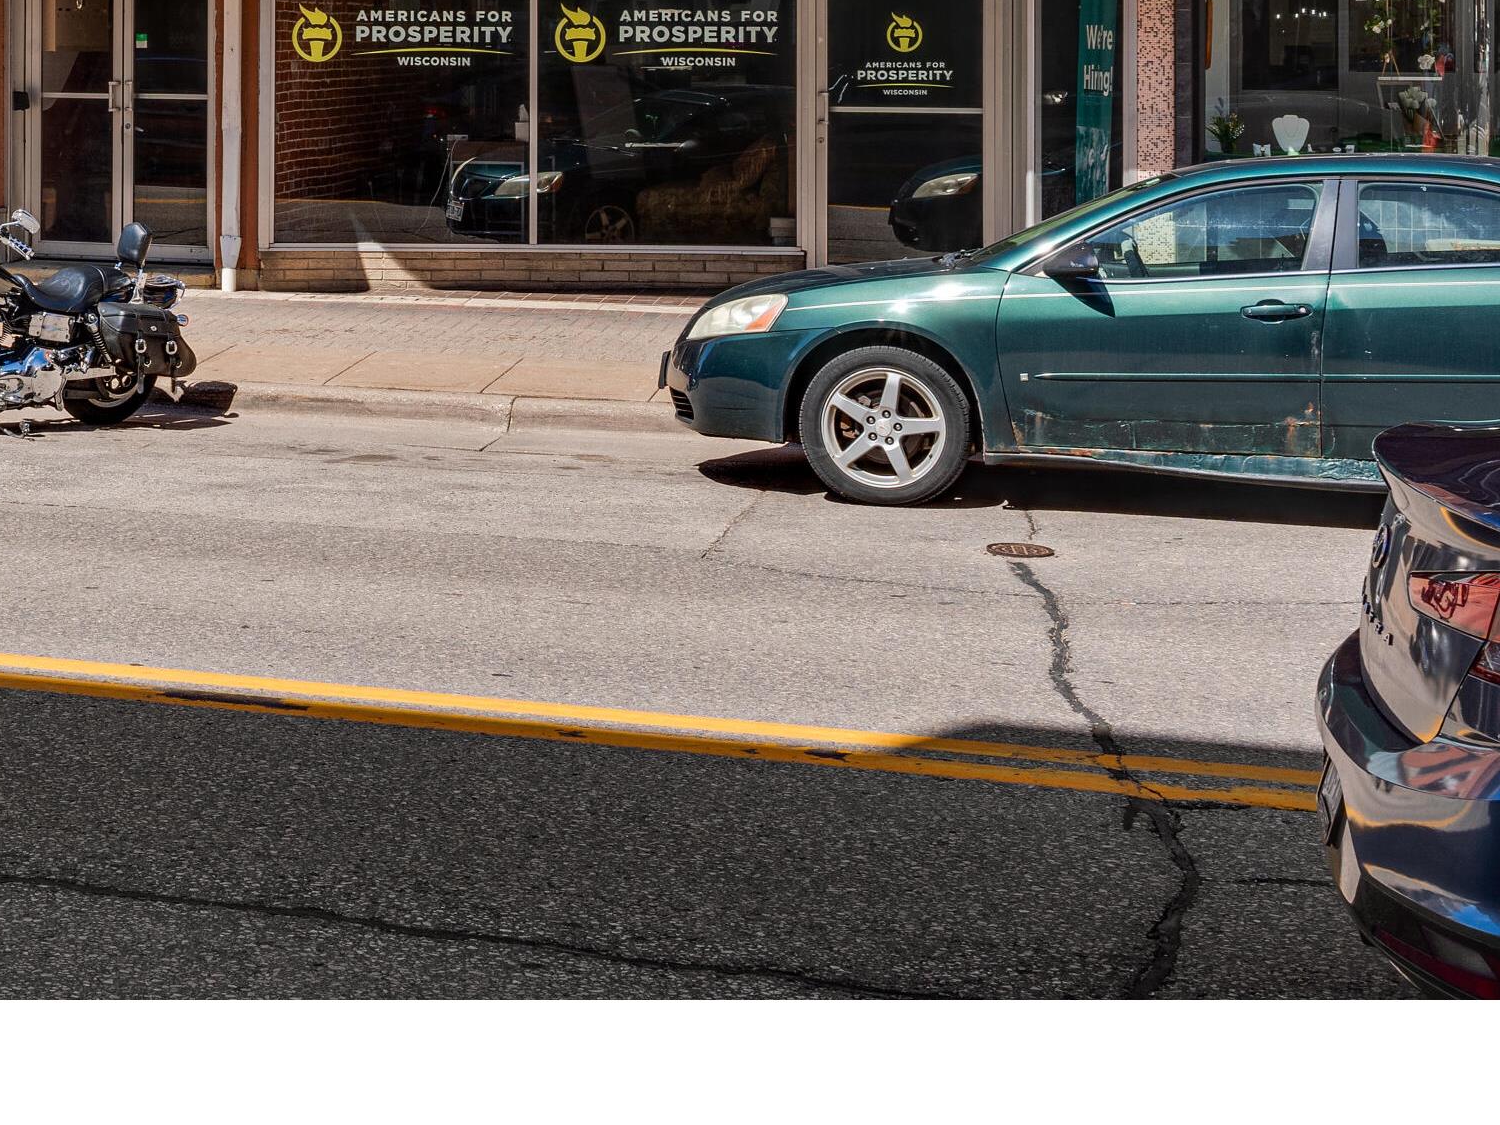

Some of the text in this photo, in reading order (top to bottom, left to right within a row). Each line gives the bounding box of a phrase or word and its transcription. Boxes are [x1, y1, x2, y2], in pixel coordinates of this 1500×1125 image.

[356, 10, 512, 22] AMERICANS FOR
[620, 10, 778, 22] AMERICANS FOR
[355, 26, 513, 43] PROSPERITY
[619, 26, 778, 43] PROSPERITY
[397, 56, 471, 67] WISCONSIN
[660, 57, 736, 67] WISCONSIN
[857, 70, 953, 81] PROSPERITY
[1083, 64, 1113, 97] Hiring!
